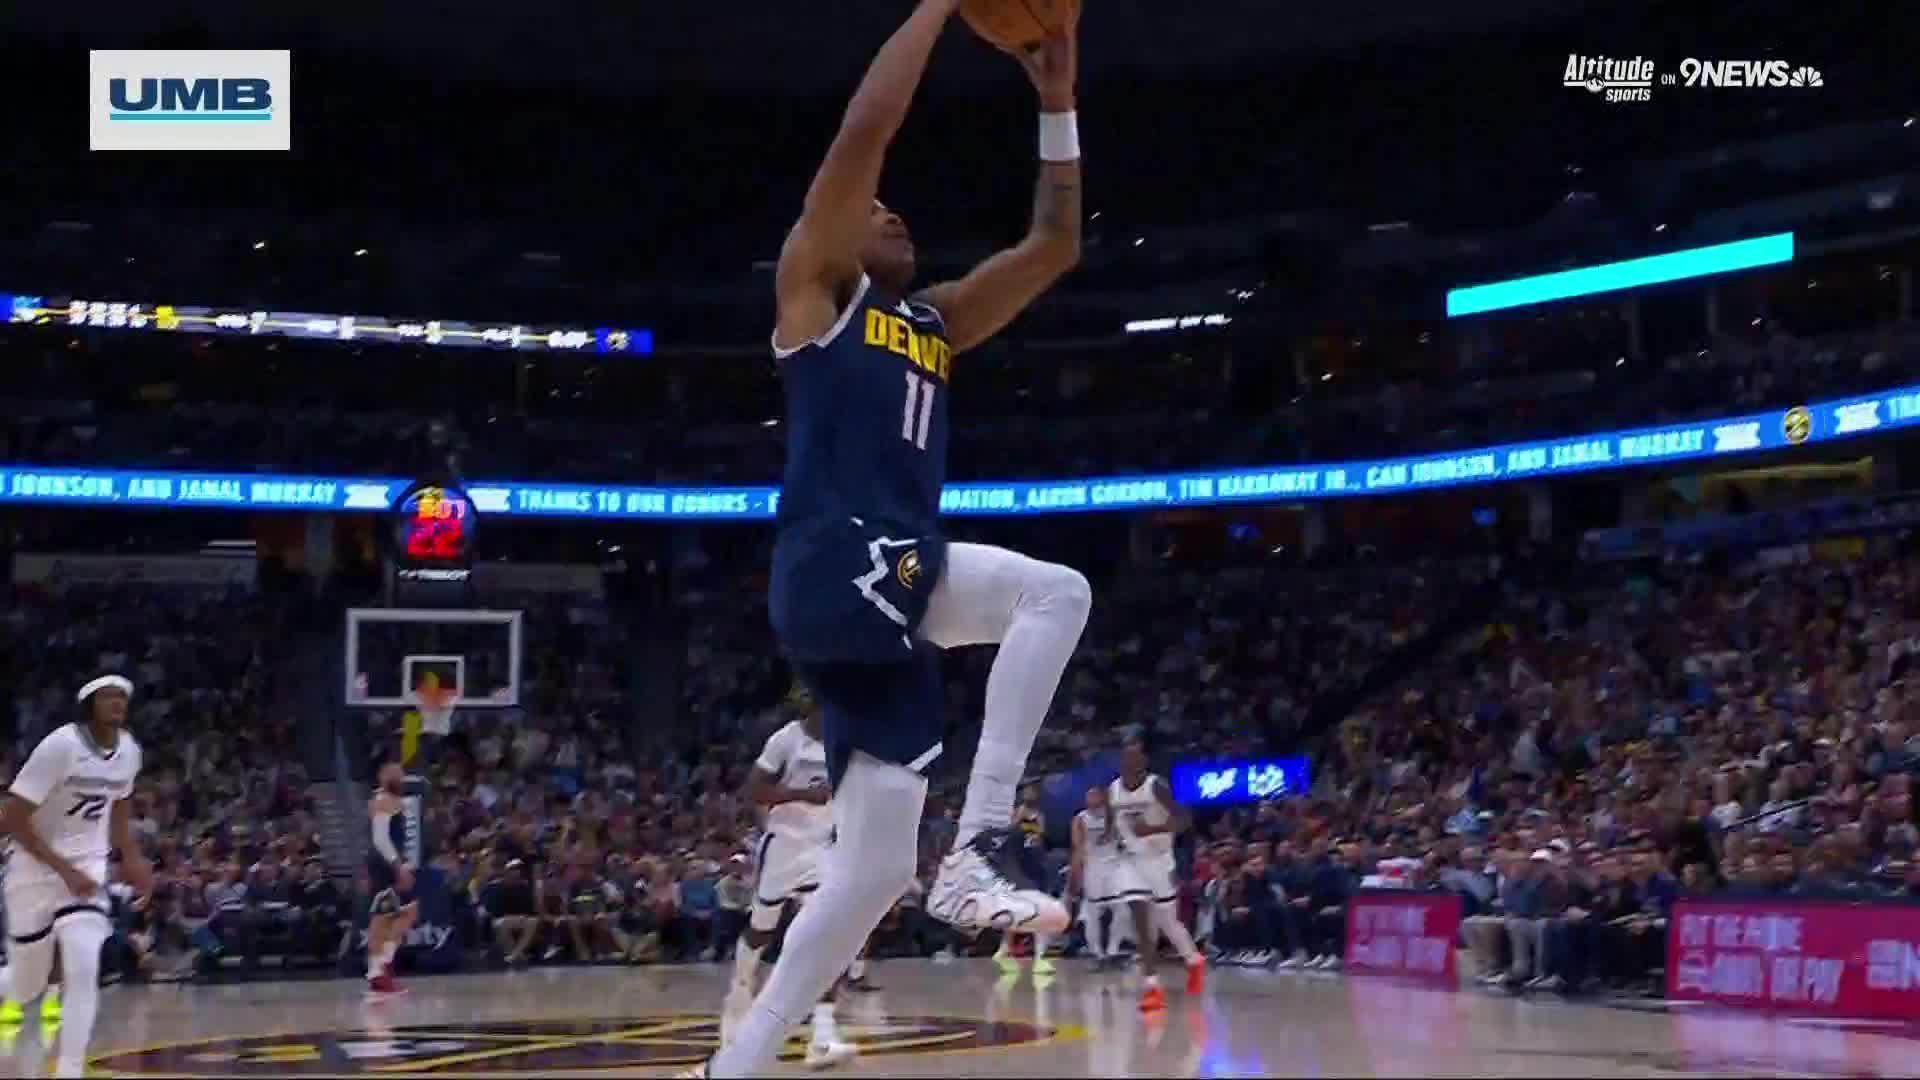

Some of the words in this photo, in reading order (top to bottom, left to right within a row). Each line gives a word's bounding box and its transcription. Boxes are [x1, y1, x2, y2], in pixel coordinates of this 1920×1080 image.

[864, 307, 952, 384] DENVE
[902, 369, 936, 450] 11
[66, 792, 107, 819] 72
